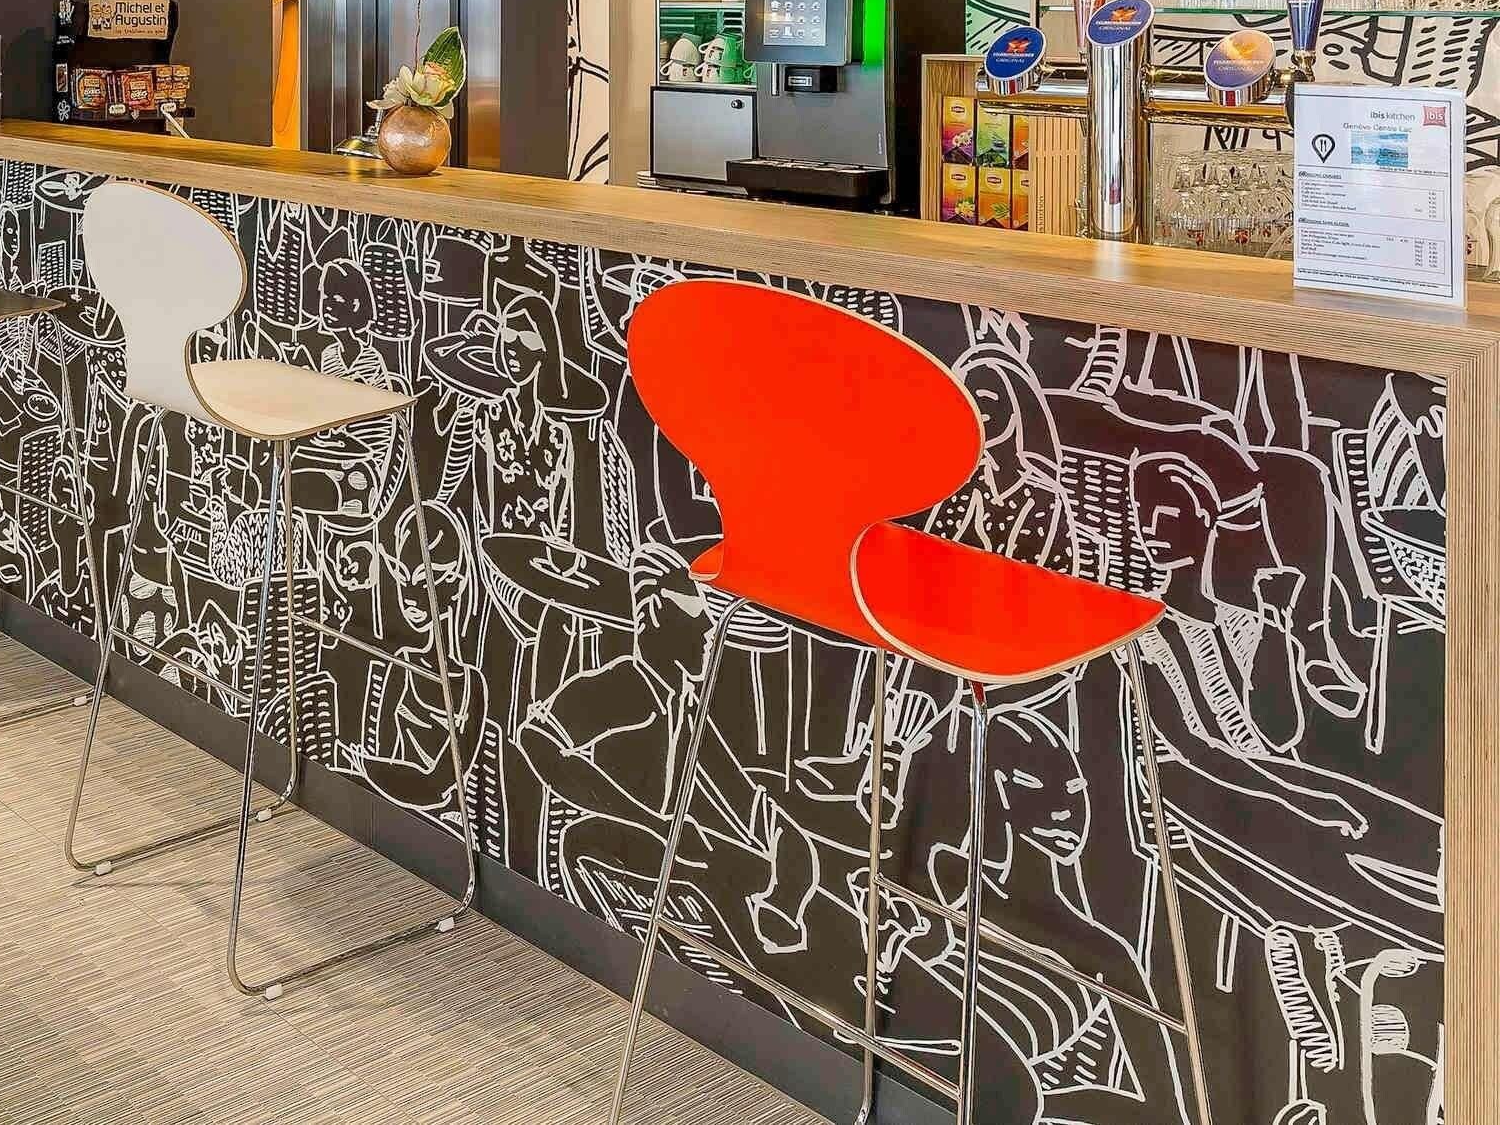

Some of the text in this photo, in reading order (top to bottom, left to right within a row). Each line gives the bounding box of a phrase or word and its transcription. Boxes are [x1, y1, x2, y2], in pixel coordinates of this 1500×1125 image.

[115, 2, 165, 13] Michel et
[115, 14, 167, 27] Augustin
[1370, 110, 1415, 121] ibis kitchen
[1426, 110, 1443, 121] ibis
